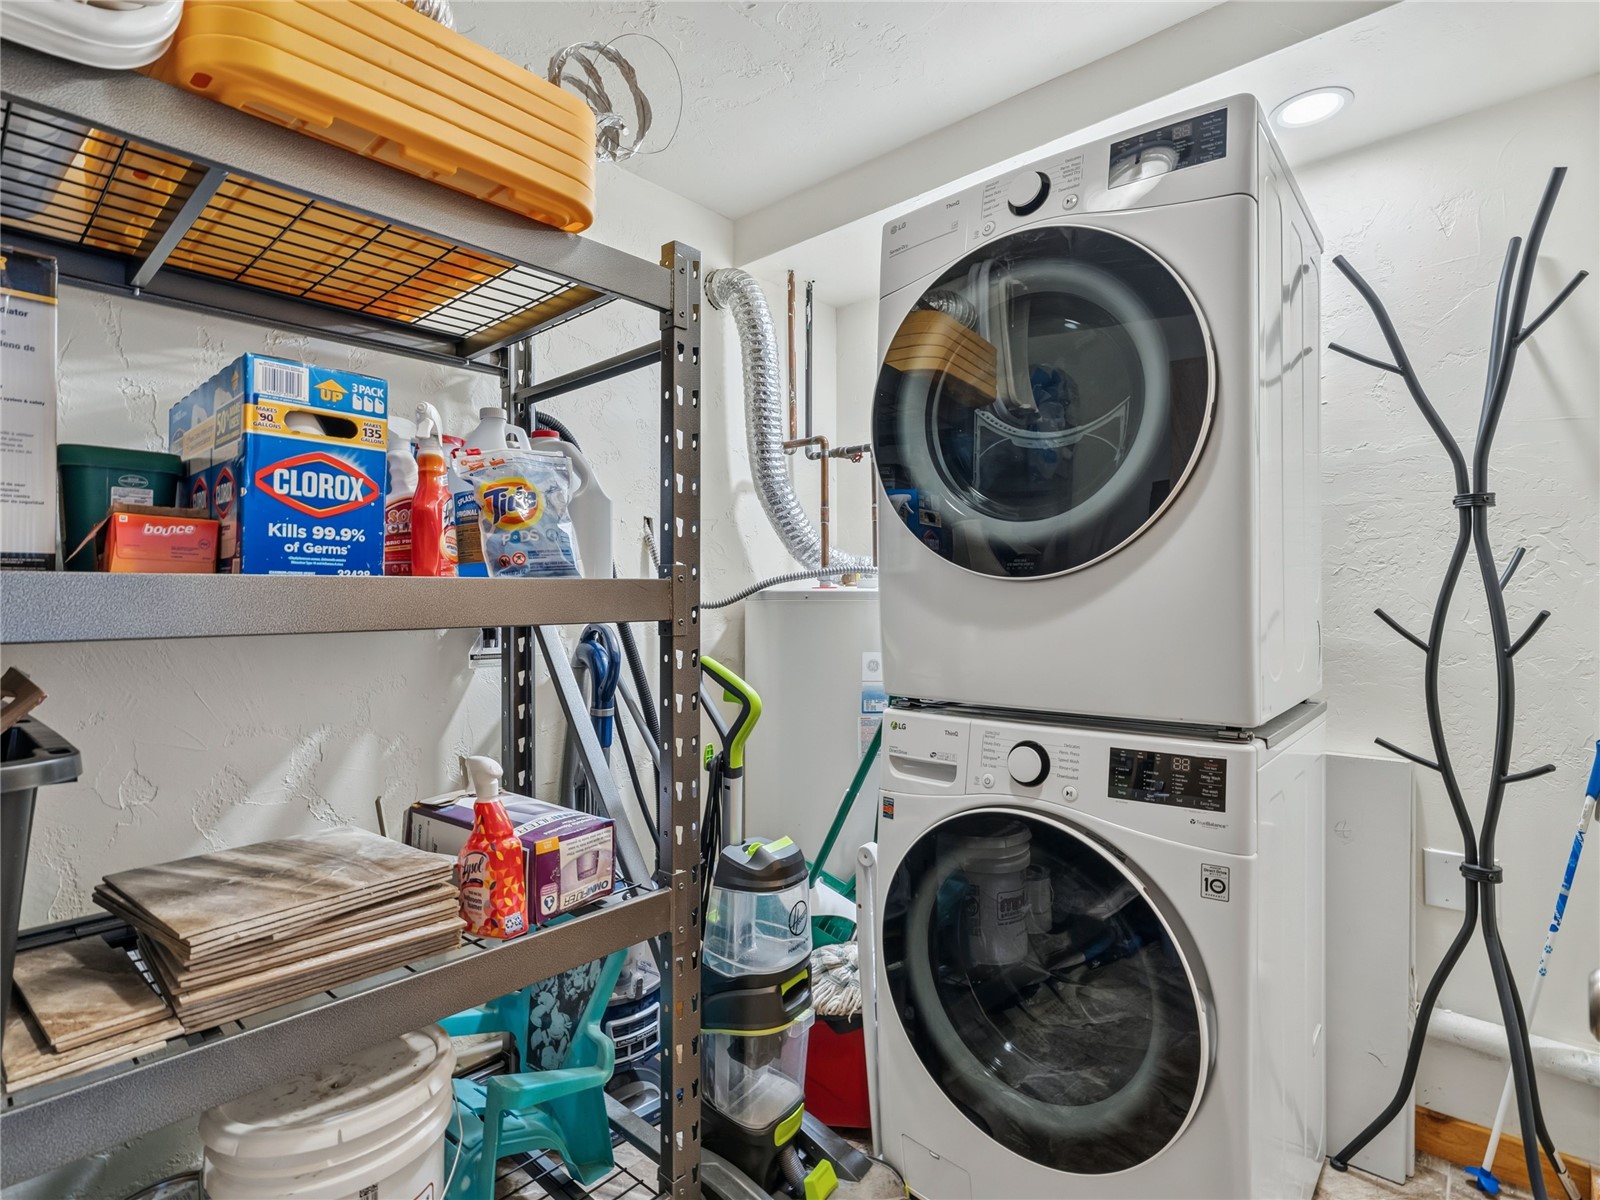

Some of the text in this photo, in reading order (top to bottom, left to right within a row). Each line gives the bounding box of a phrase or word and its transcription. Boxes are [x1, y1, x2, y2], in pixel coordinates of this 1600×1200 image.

[320, 388, 344, 403] UP
[352, 383, 385, 398] 3 PACK
[255, 405, 277, 414] MAKES
[259, 412, 274, 422] 90
[252, 421, 282, 430] GALLONS
[362, 427, 382, 440] 135
[360, 437, 385, 445] GALLONS
[273, 468, 364, 503] CLOROX
[143, 523, 195, 536] bounce
[268, 522, 366, 542] Kills 99.9%
[284, 542, 300, 553] of
[463, 856, 485, 880] Lysol
[1204, 877, 1227, 895] 10
